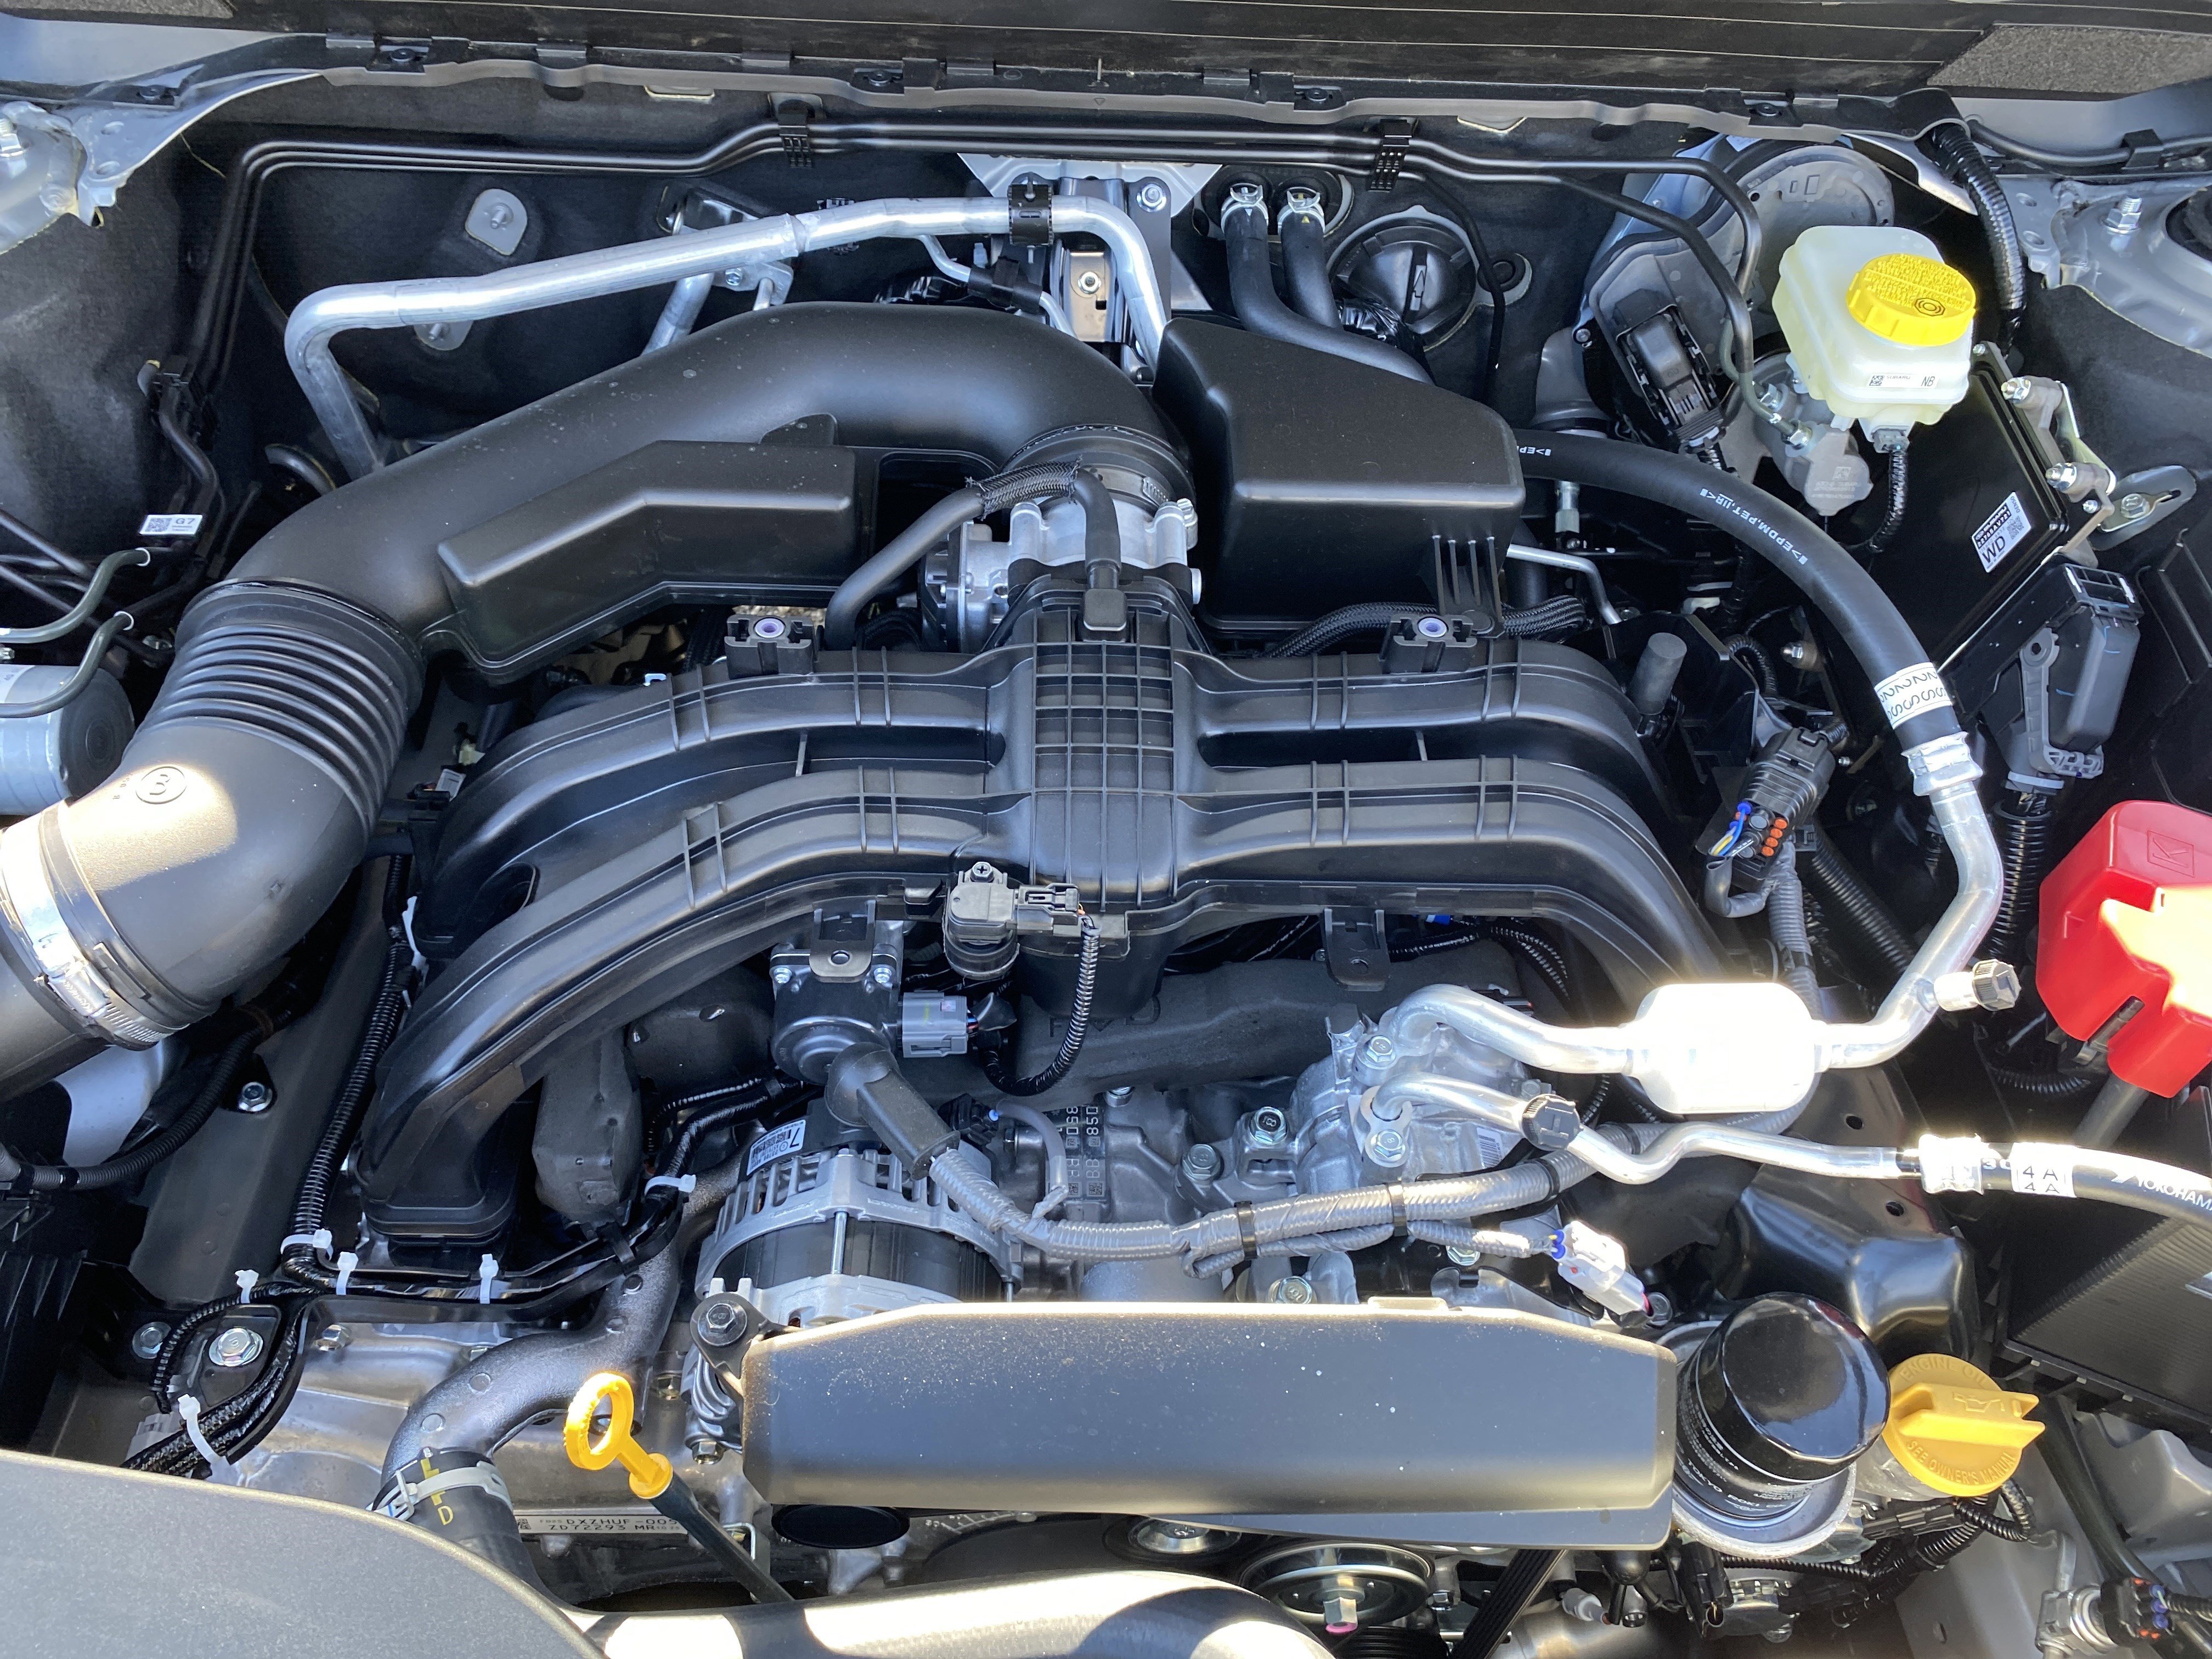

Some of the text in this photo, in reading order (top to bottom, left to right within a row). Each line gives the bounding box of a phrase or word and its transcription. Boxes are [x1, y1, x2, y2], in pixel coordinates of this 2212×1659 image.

[1921, 376, 1936, 387] NB
[2010, 496, 2021, 513] DENSO
[1982, 535, 2006, 563] WD
[789, 1127, 800, 1148] 7
[1086, 1159, 1100, 1178] BB
[2022, 1165, 2058, 1181] 4 A
[2137, 1176, 2212, 1211] YOKOHAM
[1900, 1356, 1989, 1389] ENGINE OIL
[1907, 1441, 2017, 1485] SEE OWNER'S MANUAL
[1688, 1458, 1723, 1493] TOKYO
